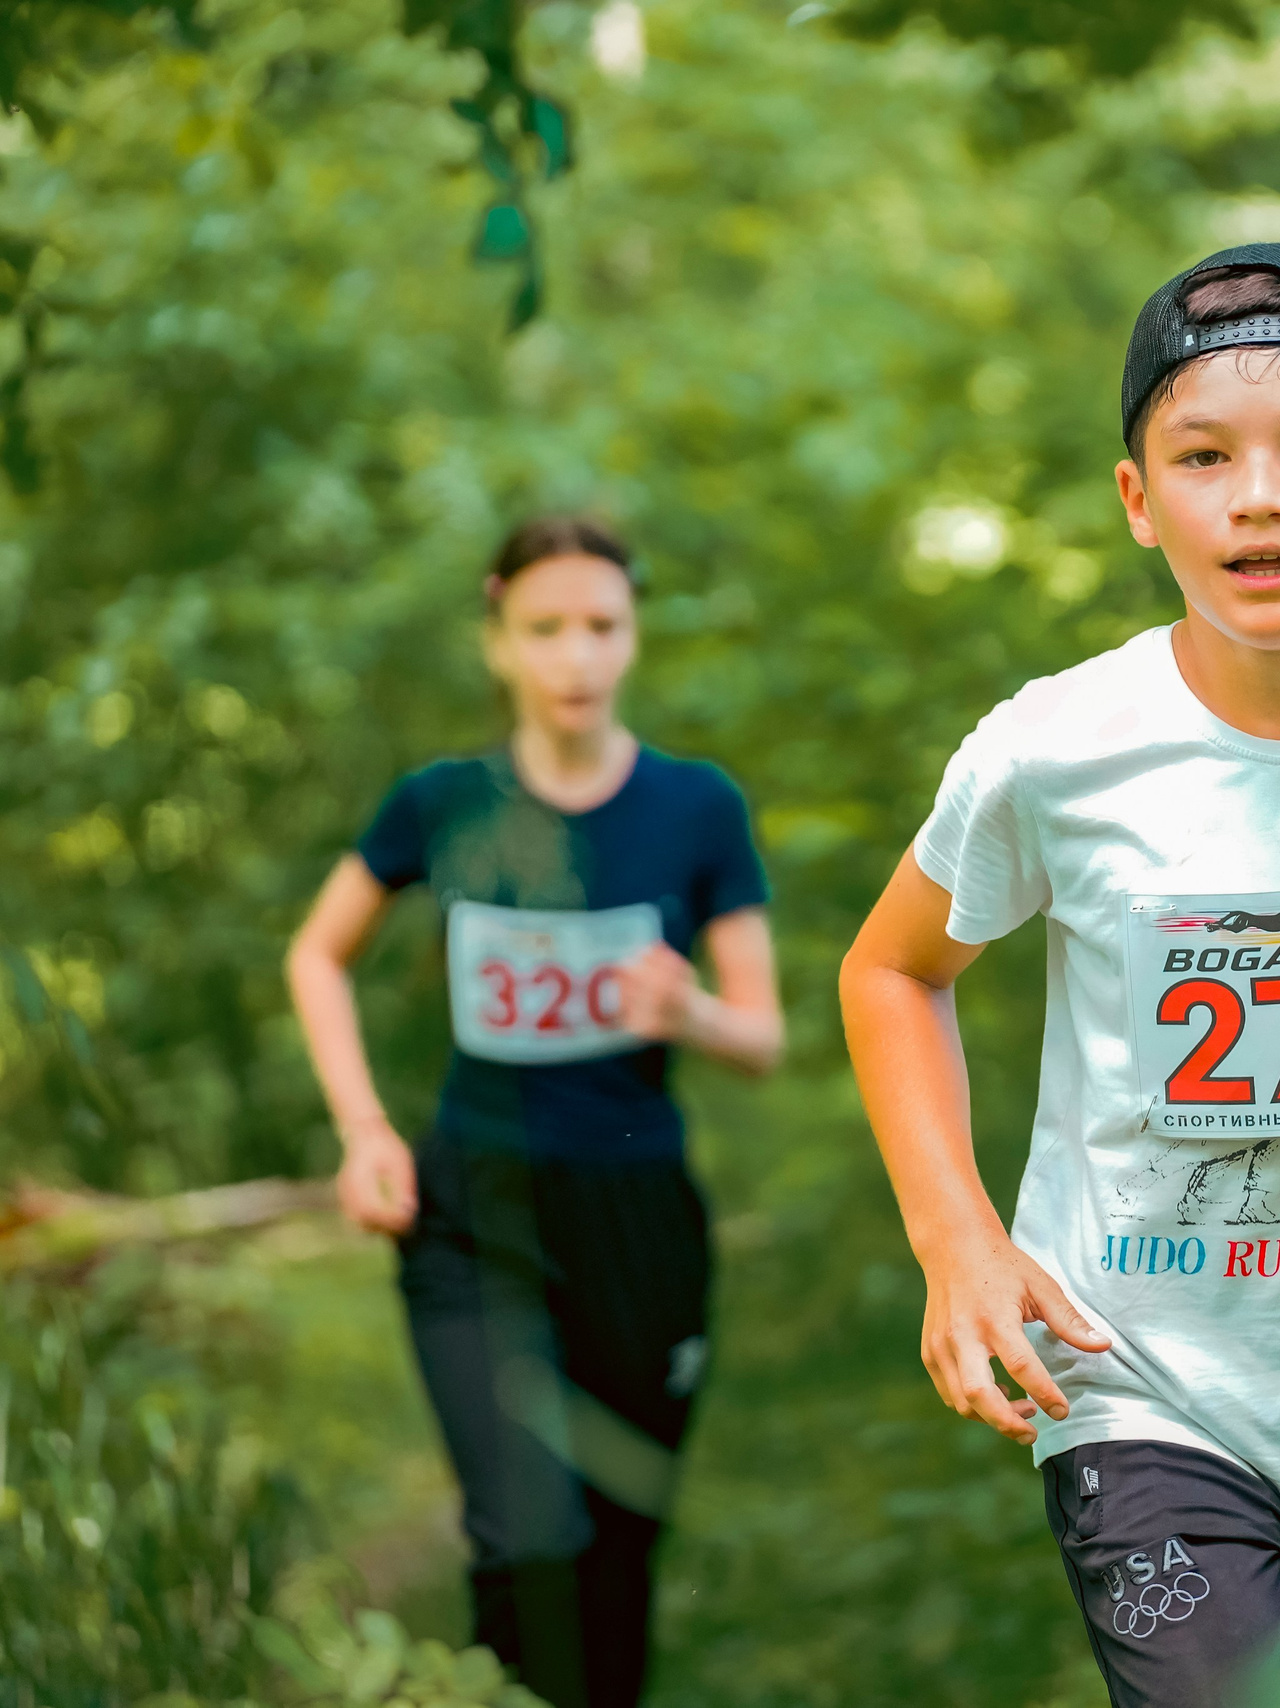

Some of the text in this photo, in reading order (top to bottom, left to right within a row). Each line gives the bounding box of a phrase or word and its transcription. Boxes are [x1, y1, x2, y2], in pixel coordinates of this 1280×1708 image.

[1101, 1235, 1206, 1275] JUDO
[1089, 1469, 1099, 1490] NIKE
[1100, 1537, 1196, 1603] USA
